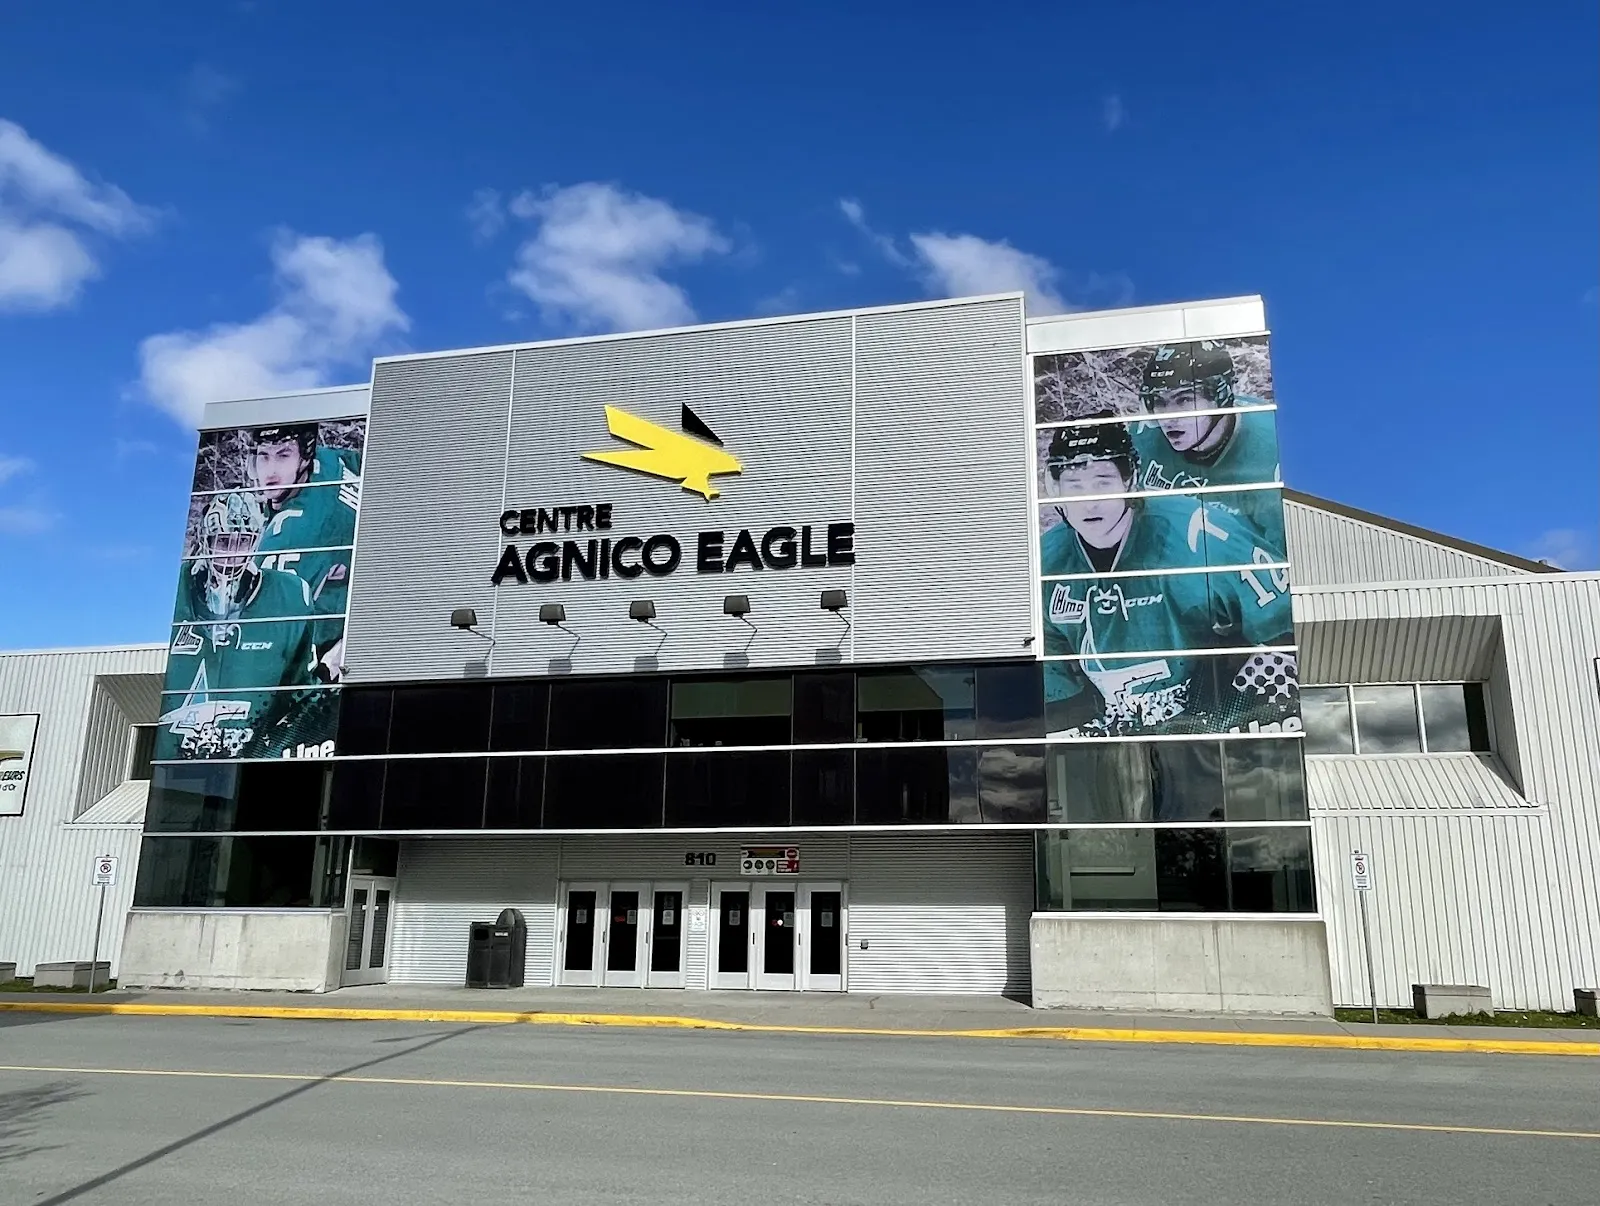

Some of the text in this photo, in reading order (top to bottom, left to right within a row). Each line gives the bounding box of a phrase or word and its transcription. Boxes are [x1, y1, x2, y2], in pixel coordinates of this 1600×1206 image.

[1068, 437, 1098, 447] CCM
[499, 503, 613, 536] CENTRE
[491, 522, 856, 586] AGNICO EAGLE
[685, 853, 716, 866] 810
